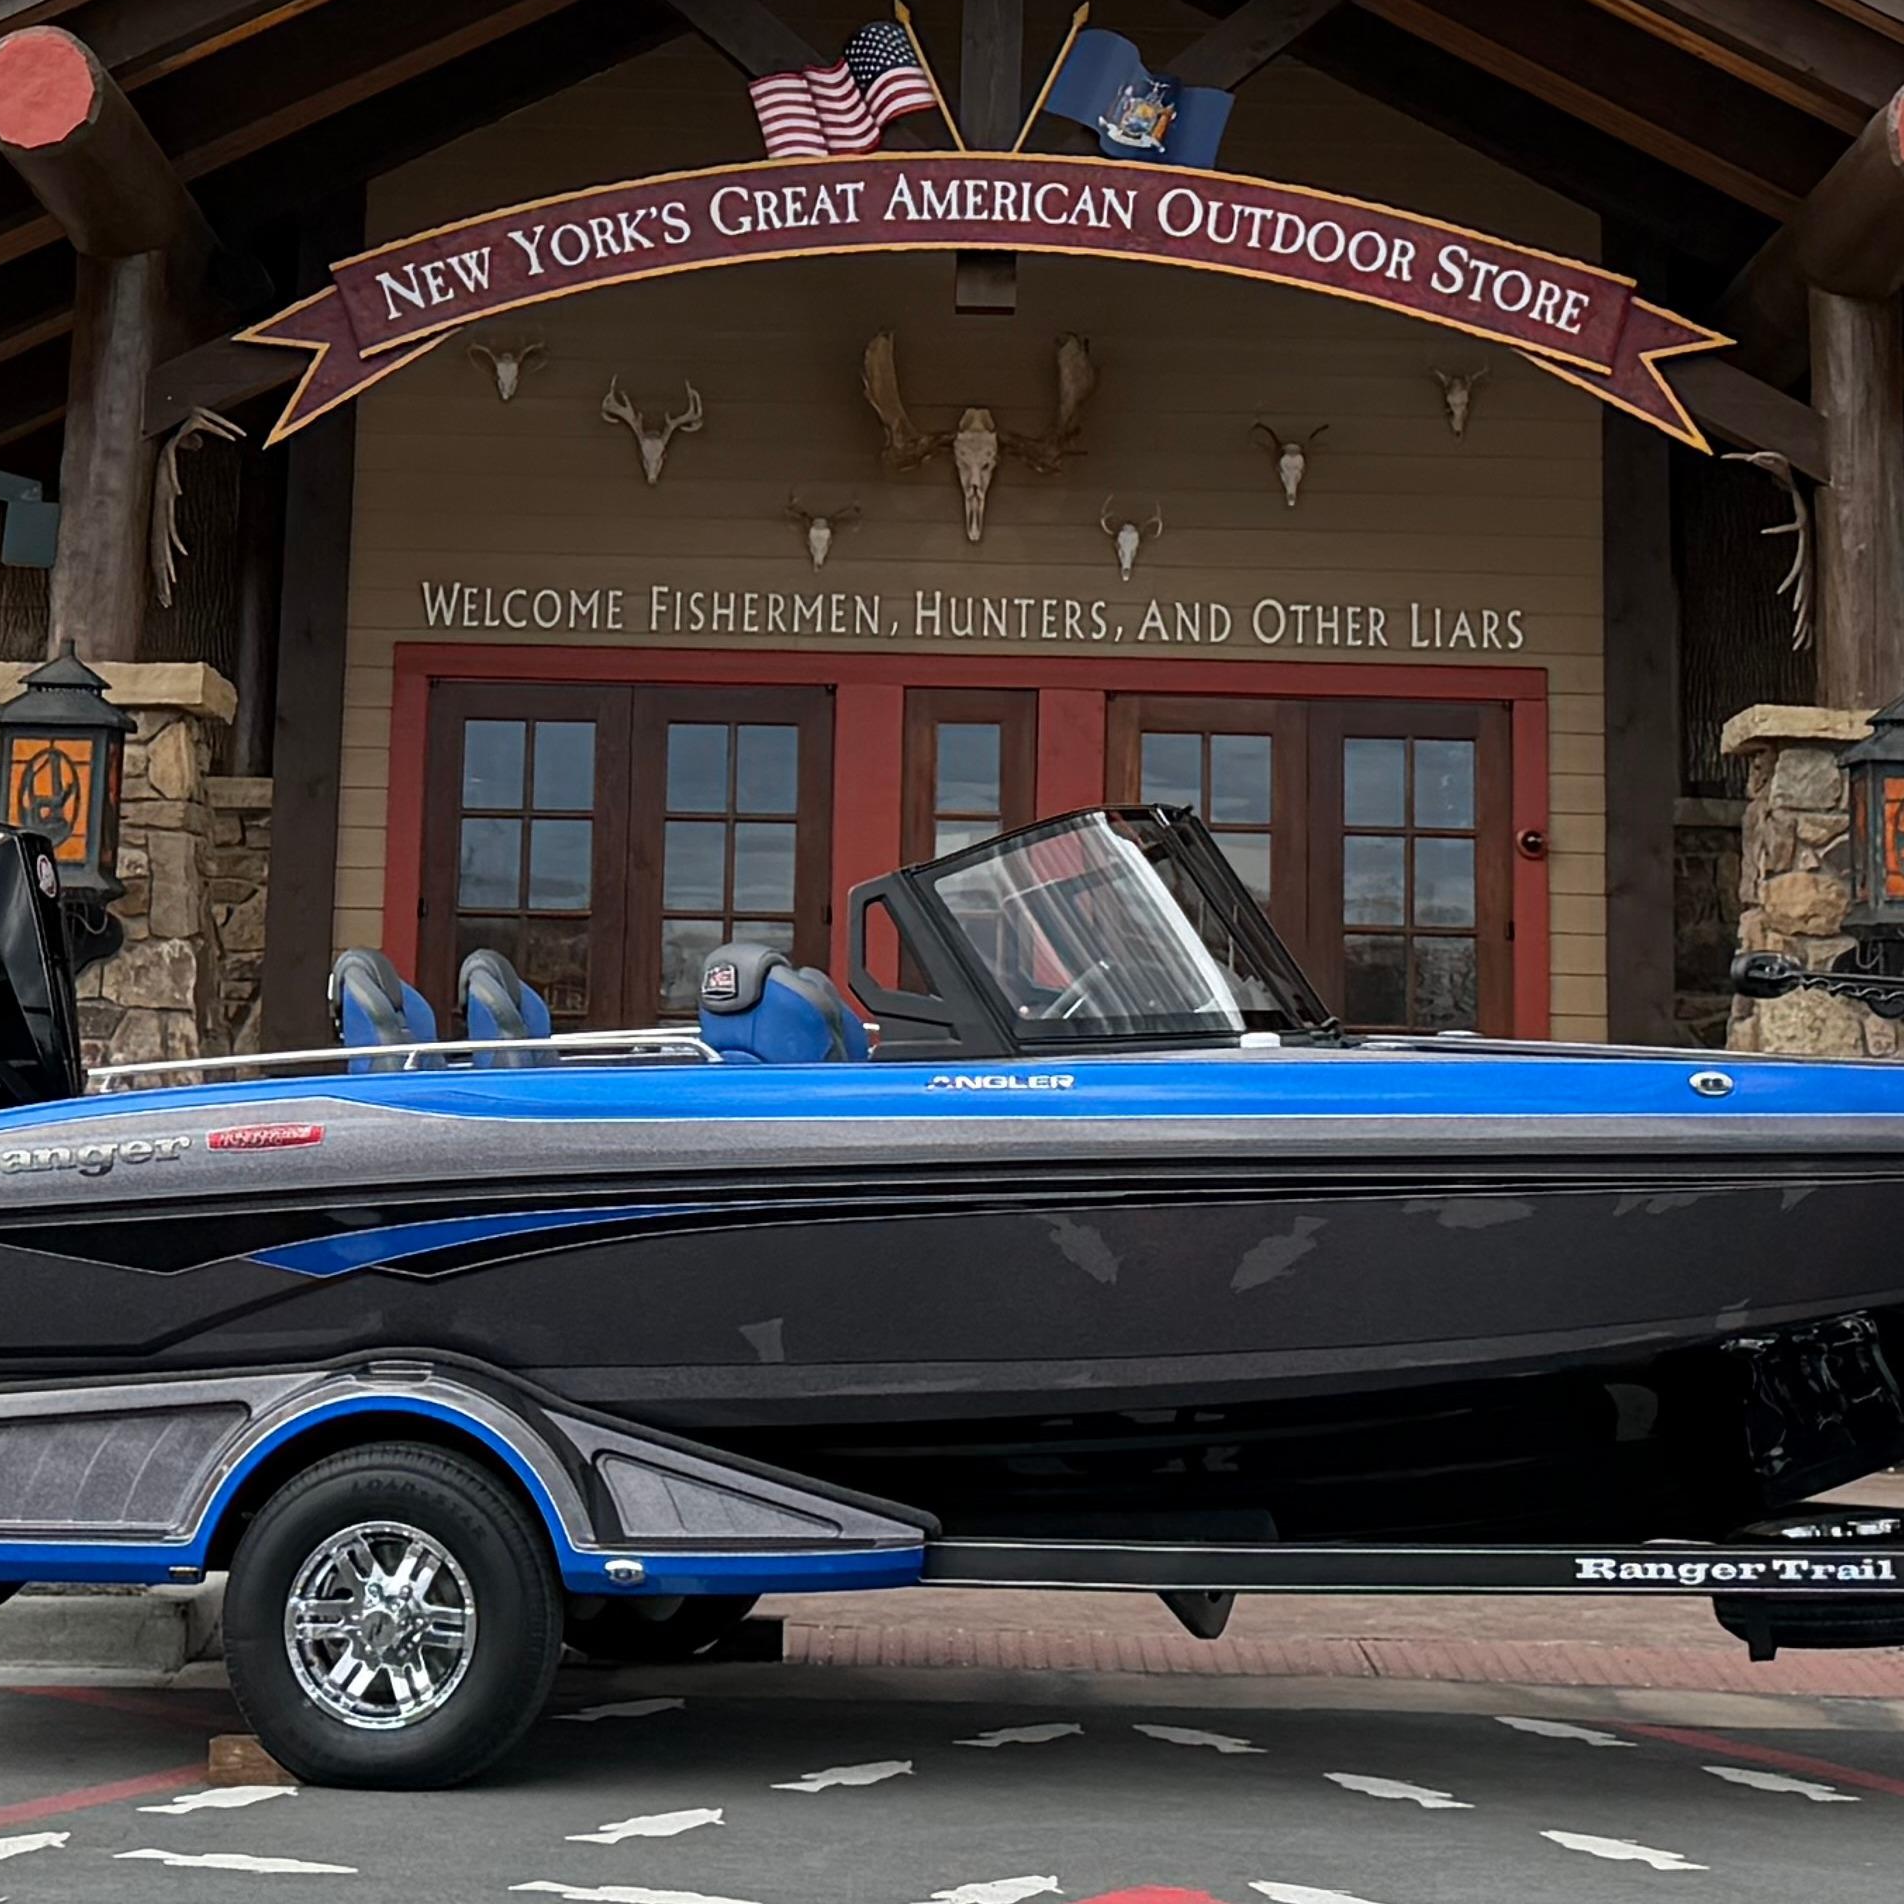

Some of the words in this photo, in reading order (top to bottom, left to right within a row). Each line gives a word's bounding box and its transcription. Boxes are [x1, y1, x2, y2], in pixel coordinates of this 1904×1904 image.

[375, 245, 492, 321] NEW
[507, 201, 692, 277] YORK'S
[710, 179, 866, 238] GREAT
[883, 172, 1137, 231] AMERICAN
[1156, 187, 1417, 283] OUTDOOR
[1430, 244, 1590, 336] STORE
[421, 581, 624, 631] WELCOME
[649, 585, 899, 638] FISHERMEN,
[914, 590, 1124, 643] HUNTERS,
[1137, 598, 1232, 644] AND
[1252, 597, 1390, 648] OTHER
[1410, 602, 1525, 650] LIARS
[925, 1073, 1076, 1091] ANGLER
[1575, 1557, 1767, 1586] Ranger
[1771, 1557, 1896, 1581] Trail
